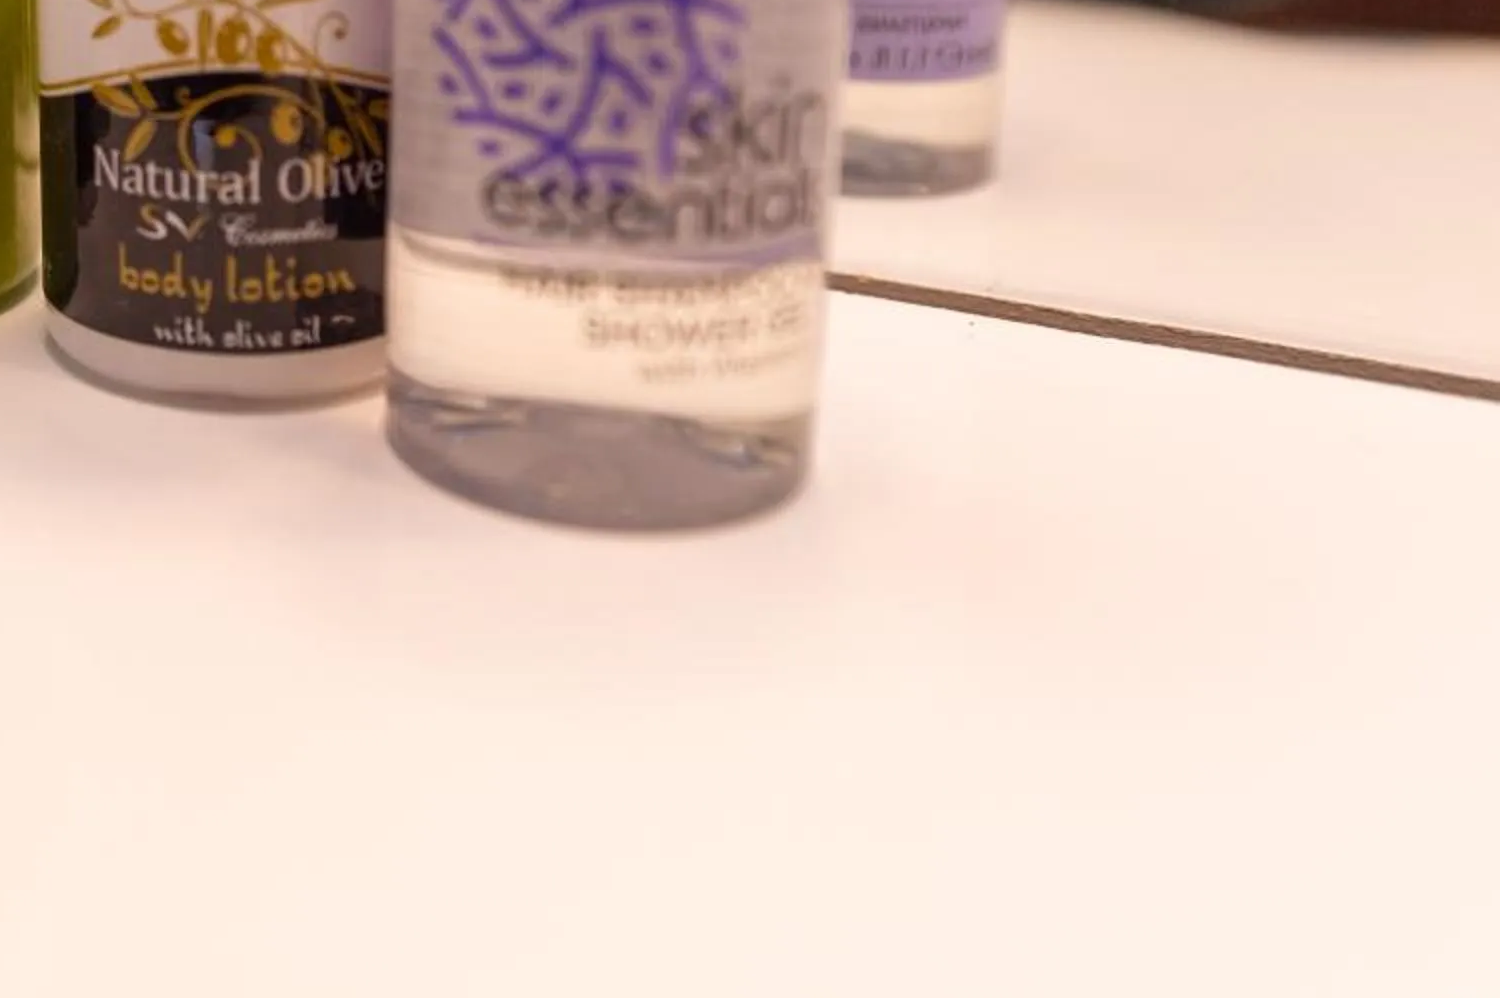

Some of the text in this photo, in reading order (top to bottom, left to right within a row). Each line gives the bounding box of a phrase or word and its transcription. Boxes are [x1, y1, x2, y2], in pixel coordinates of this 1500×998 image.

[93, 144, 386, 205] Natural Olive
[218, 212, 338, 248] Cosmetics
[118, 242, 356, 314] body lotion
[154, 316, 321, 349] with olive oil
